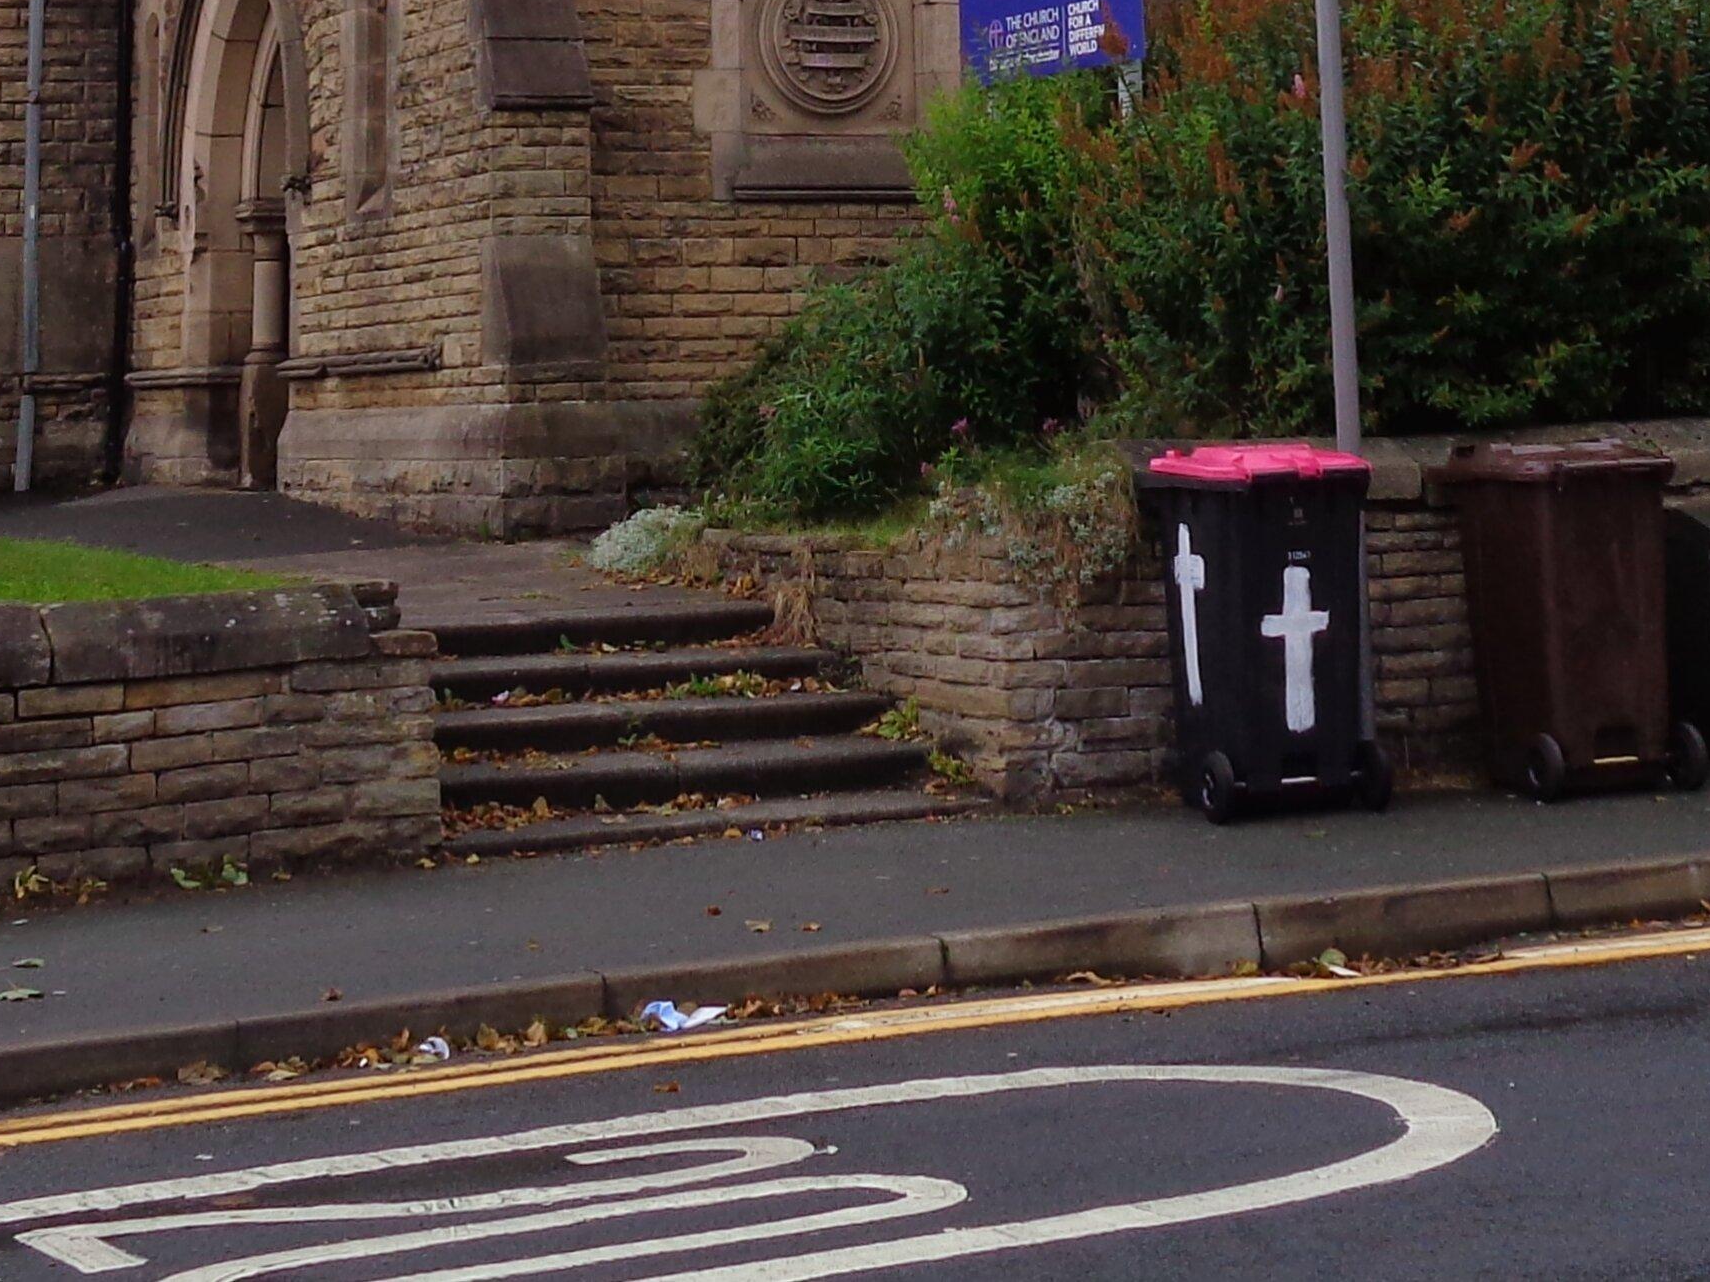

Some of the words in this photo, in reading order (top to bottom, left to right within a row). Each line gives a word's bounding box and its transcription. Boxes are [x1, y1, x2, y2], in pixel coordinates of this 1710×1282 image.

[1006, 14, 1022, 32] THE
[1023, 6, 1059, 28] CHURCH
[1068, 16, 1084, 31] FOR
[1084, 14, 1091, 28] A
[1006, 33, 1018, 49] OF
[1019, 25, 1060, 46] ENGLAND
[1068, 23, 1105, 44] DIFFEREN
[1068, 40, 1097, 57] WORLD
